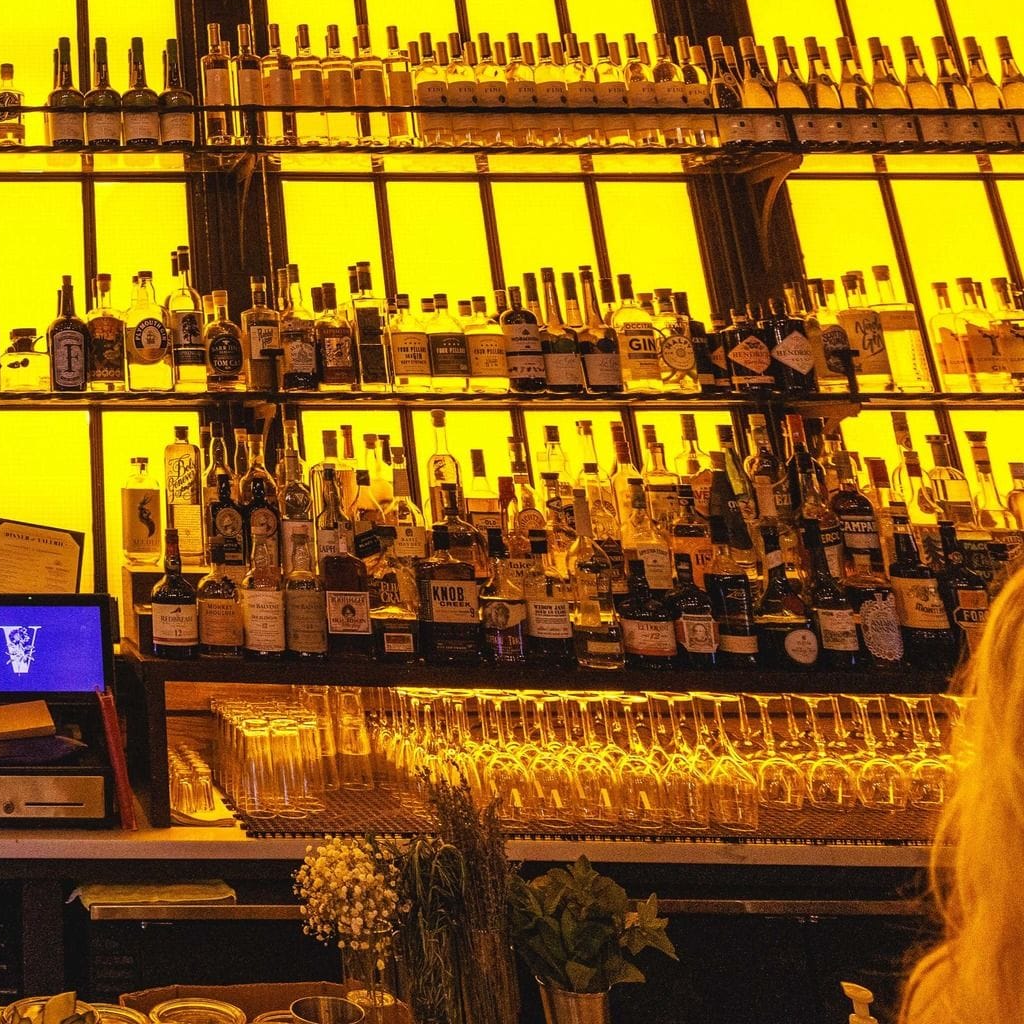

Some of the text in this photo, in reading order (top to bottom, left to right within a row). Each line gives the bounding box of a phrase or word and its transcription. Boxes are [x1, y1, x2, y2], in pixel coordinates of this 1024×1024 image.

[135, 320, 162, 341] PLYMOUTH
[160, 328, 168, 341] GIN
[628, 338, 657, 352] GIN
[64, 343, 82, 373] F
[214, 359, 229, 367] TOM
[432, 585, 465, 602] KNOB
[469, 608, 475, 618] 9
[174, 629, 182, 637] 12
[649, 632, 661, 640] 12
